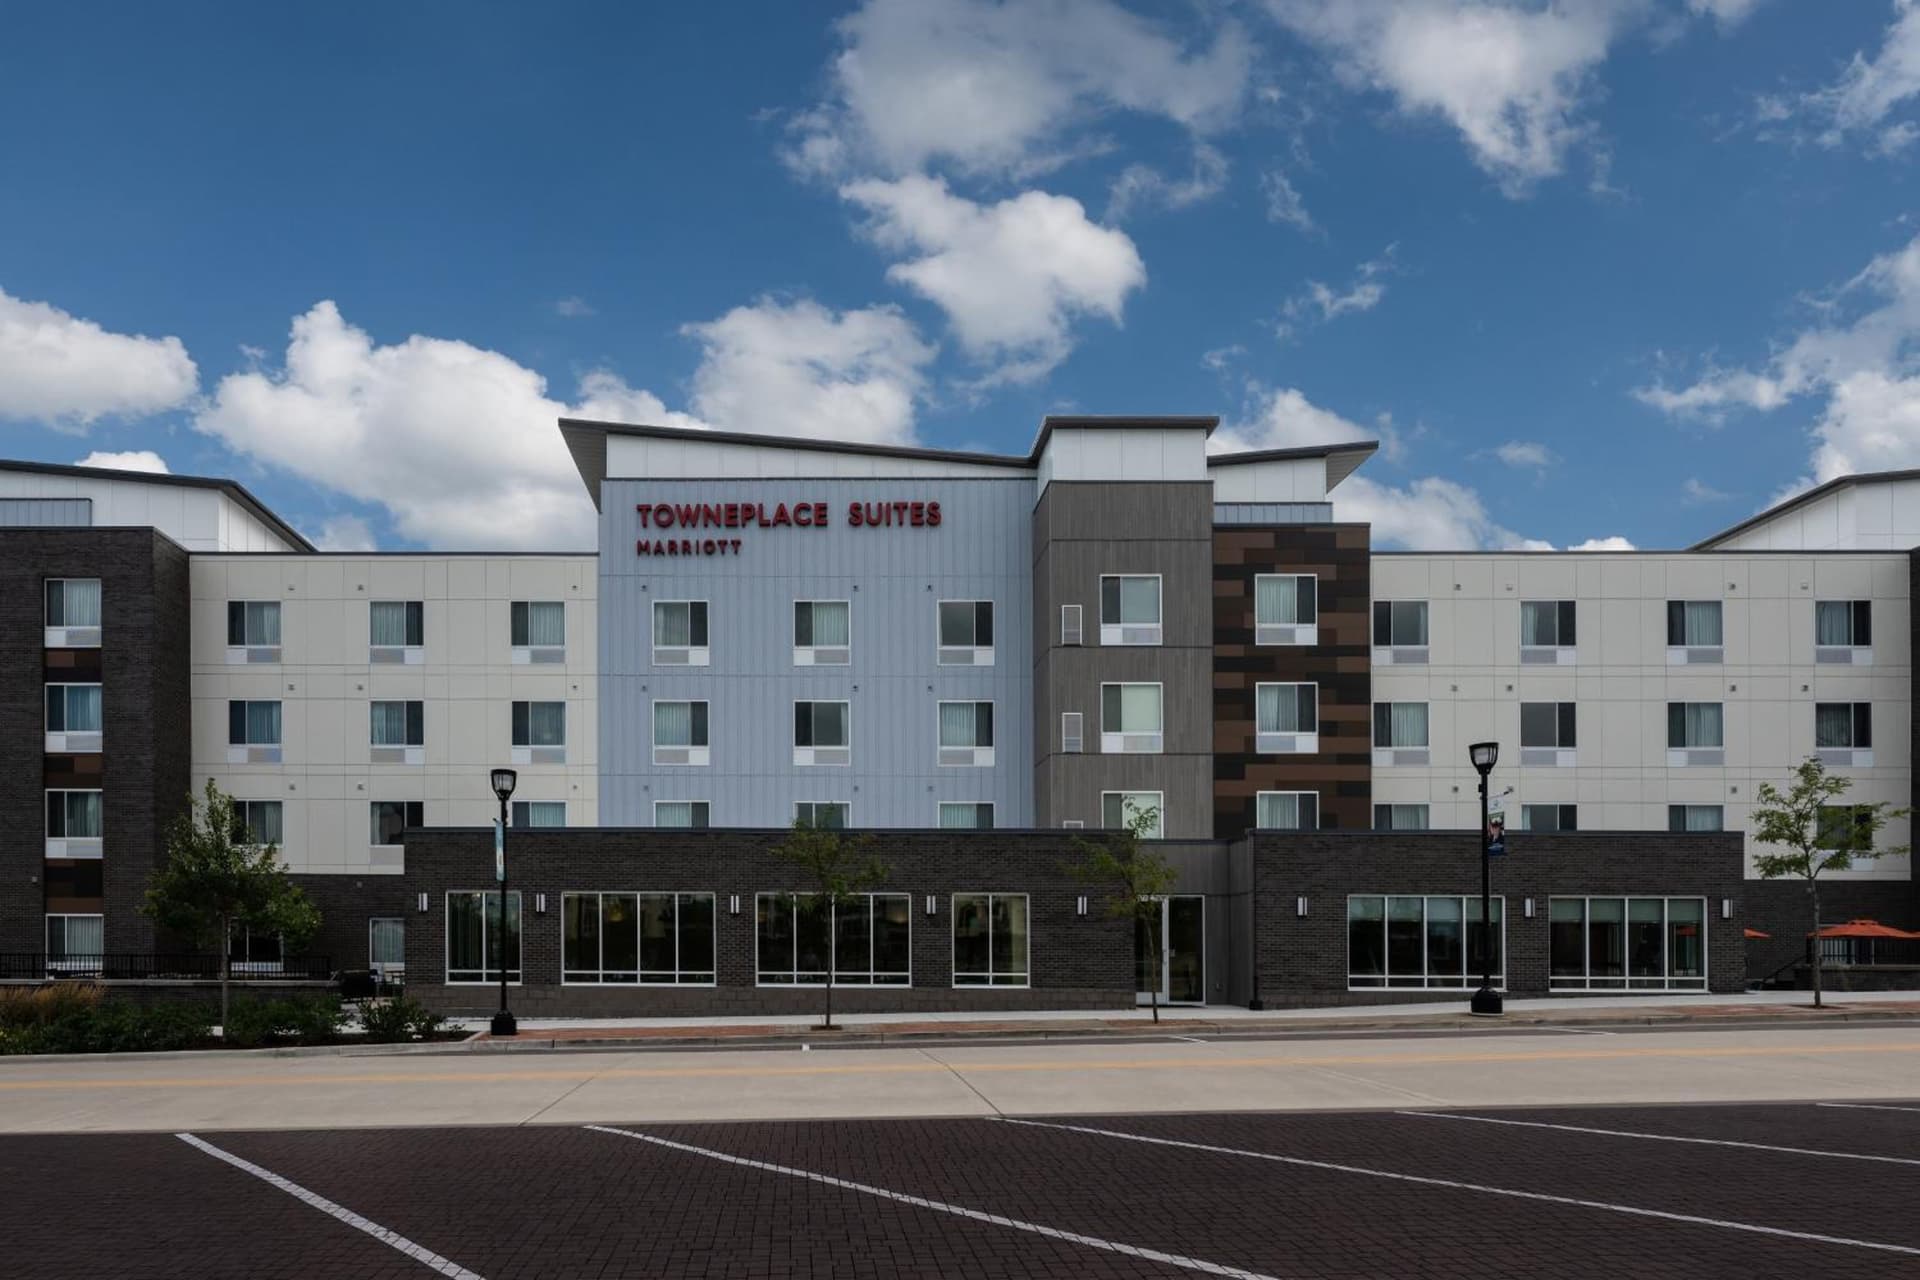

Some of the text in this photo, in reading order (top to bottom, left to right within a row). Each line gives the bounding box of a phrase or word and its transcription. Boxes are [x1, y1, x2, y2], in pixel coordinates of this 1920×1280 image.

[637, 502, 942, 528] TOWNEPLACE SUITES
[637, 539, 742, 556] MARRIOTT
